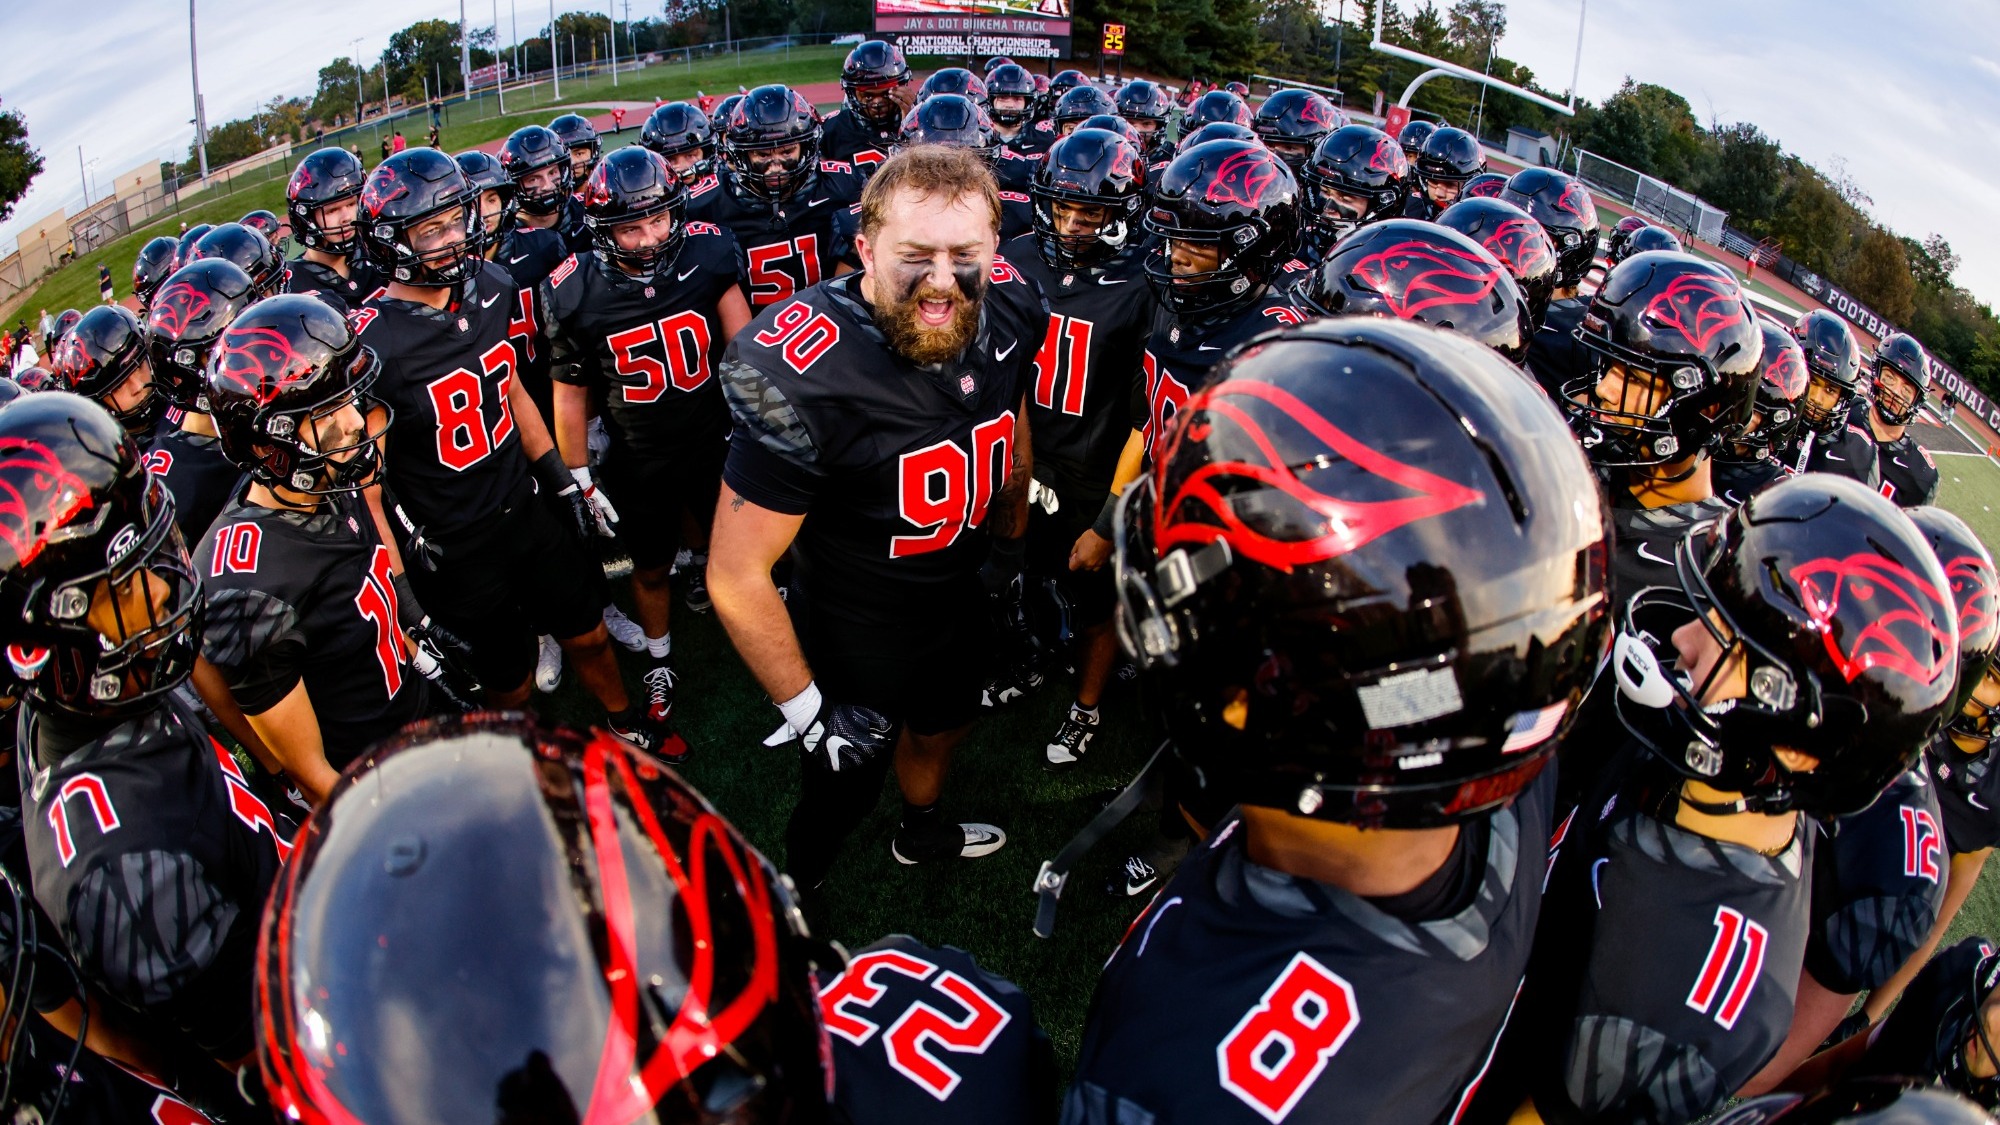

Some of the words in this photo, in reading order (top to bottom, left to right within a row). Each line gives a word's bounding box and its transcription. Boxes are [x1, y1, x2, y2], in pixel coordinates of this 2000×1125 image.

[896, 36, 909, 47] 47
[912, 36, 963, 47] NATIONAL
[966, 36, 1051, 48] CHAMPIONSHIPS
[903, 18, 924, 30] JAY
[926, 18, 934, 30] &
[938, 18, 959, 30] DOT
[963, 18, 1008, 31] BUIKEMA
[1012, 20, 1046, 33] TRACK
[976, 46, 1060, 59] CHAMPIONSHIPS
[1104, 33, 1123, 50] 25
[747, 233, 822, 307] 51
[606, 309, 713, 404] 50
[754, 300, 840, 376] 90
[1826, 288, 1895, 341] FOOTBA
[1931, 360, 1986, 419] TIONAL
[426, 339, 518, 473] 83
[889, 409, 1016, 560] 90
[211, 521, 263, 578] 10
[1627, 644, 1651, 673] SHOCK
[47, 771, 121, 869] 17
[1900, 805, 1942, 885] 12
[1685, 904, 1769, 1032] 11
[817, 948, 1013, 1102] 23
[1216, 950, 1360, 1125] 8
